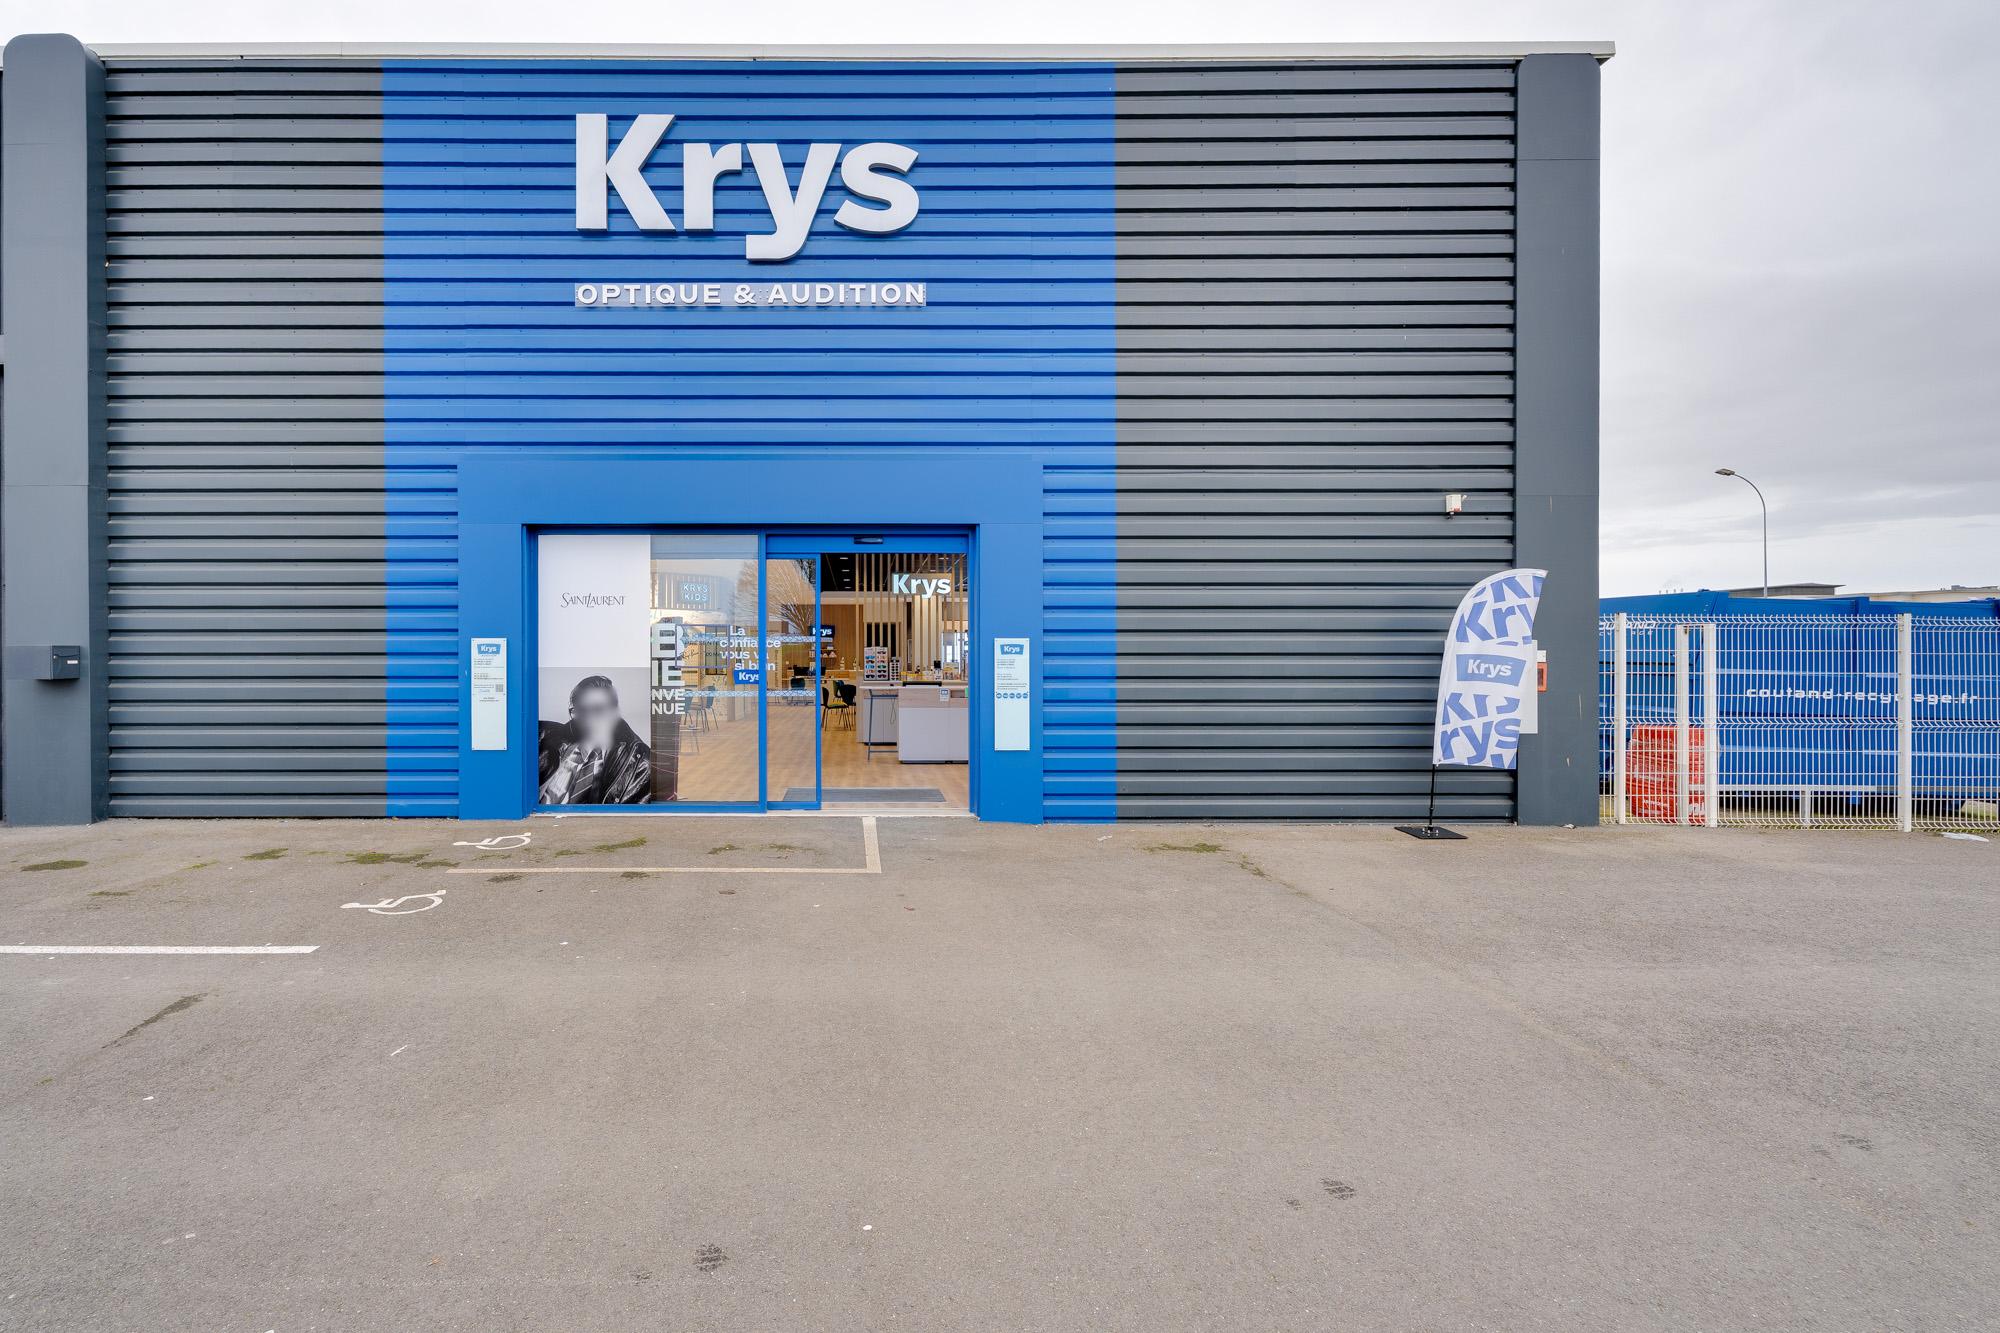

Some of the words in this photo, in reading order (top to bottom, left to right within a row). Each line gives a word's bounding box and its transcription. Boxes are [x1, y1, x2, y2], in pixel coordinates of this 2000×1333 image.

[575, 113, 920, 262] Krys
[577, 284, 721, 304] OPTIQUE
[734, 284, 757, 304] &
[767, 284, 925, 304] AUDITION
[683, 583, 709, 593] KRYS
[893, 574, 951, 599] Krys
[684, 592, 708, 601] KIDS
[730, 626, 746, 636] La
[720, 637, 781, 648] confiace
[720, 651, 750, 659] vous
[735, 661, 745, 670] si
[1467, 659, 1512, 678] Krys
[1746, 687, 1978, 705] coutand-recycage.fr
[652, 702, 686, 715] NUE
